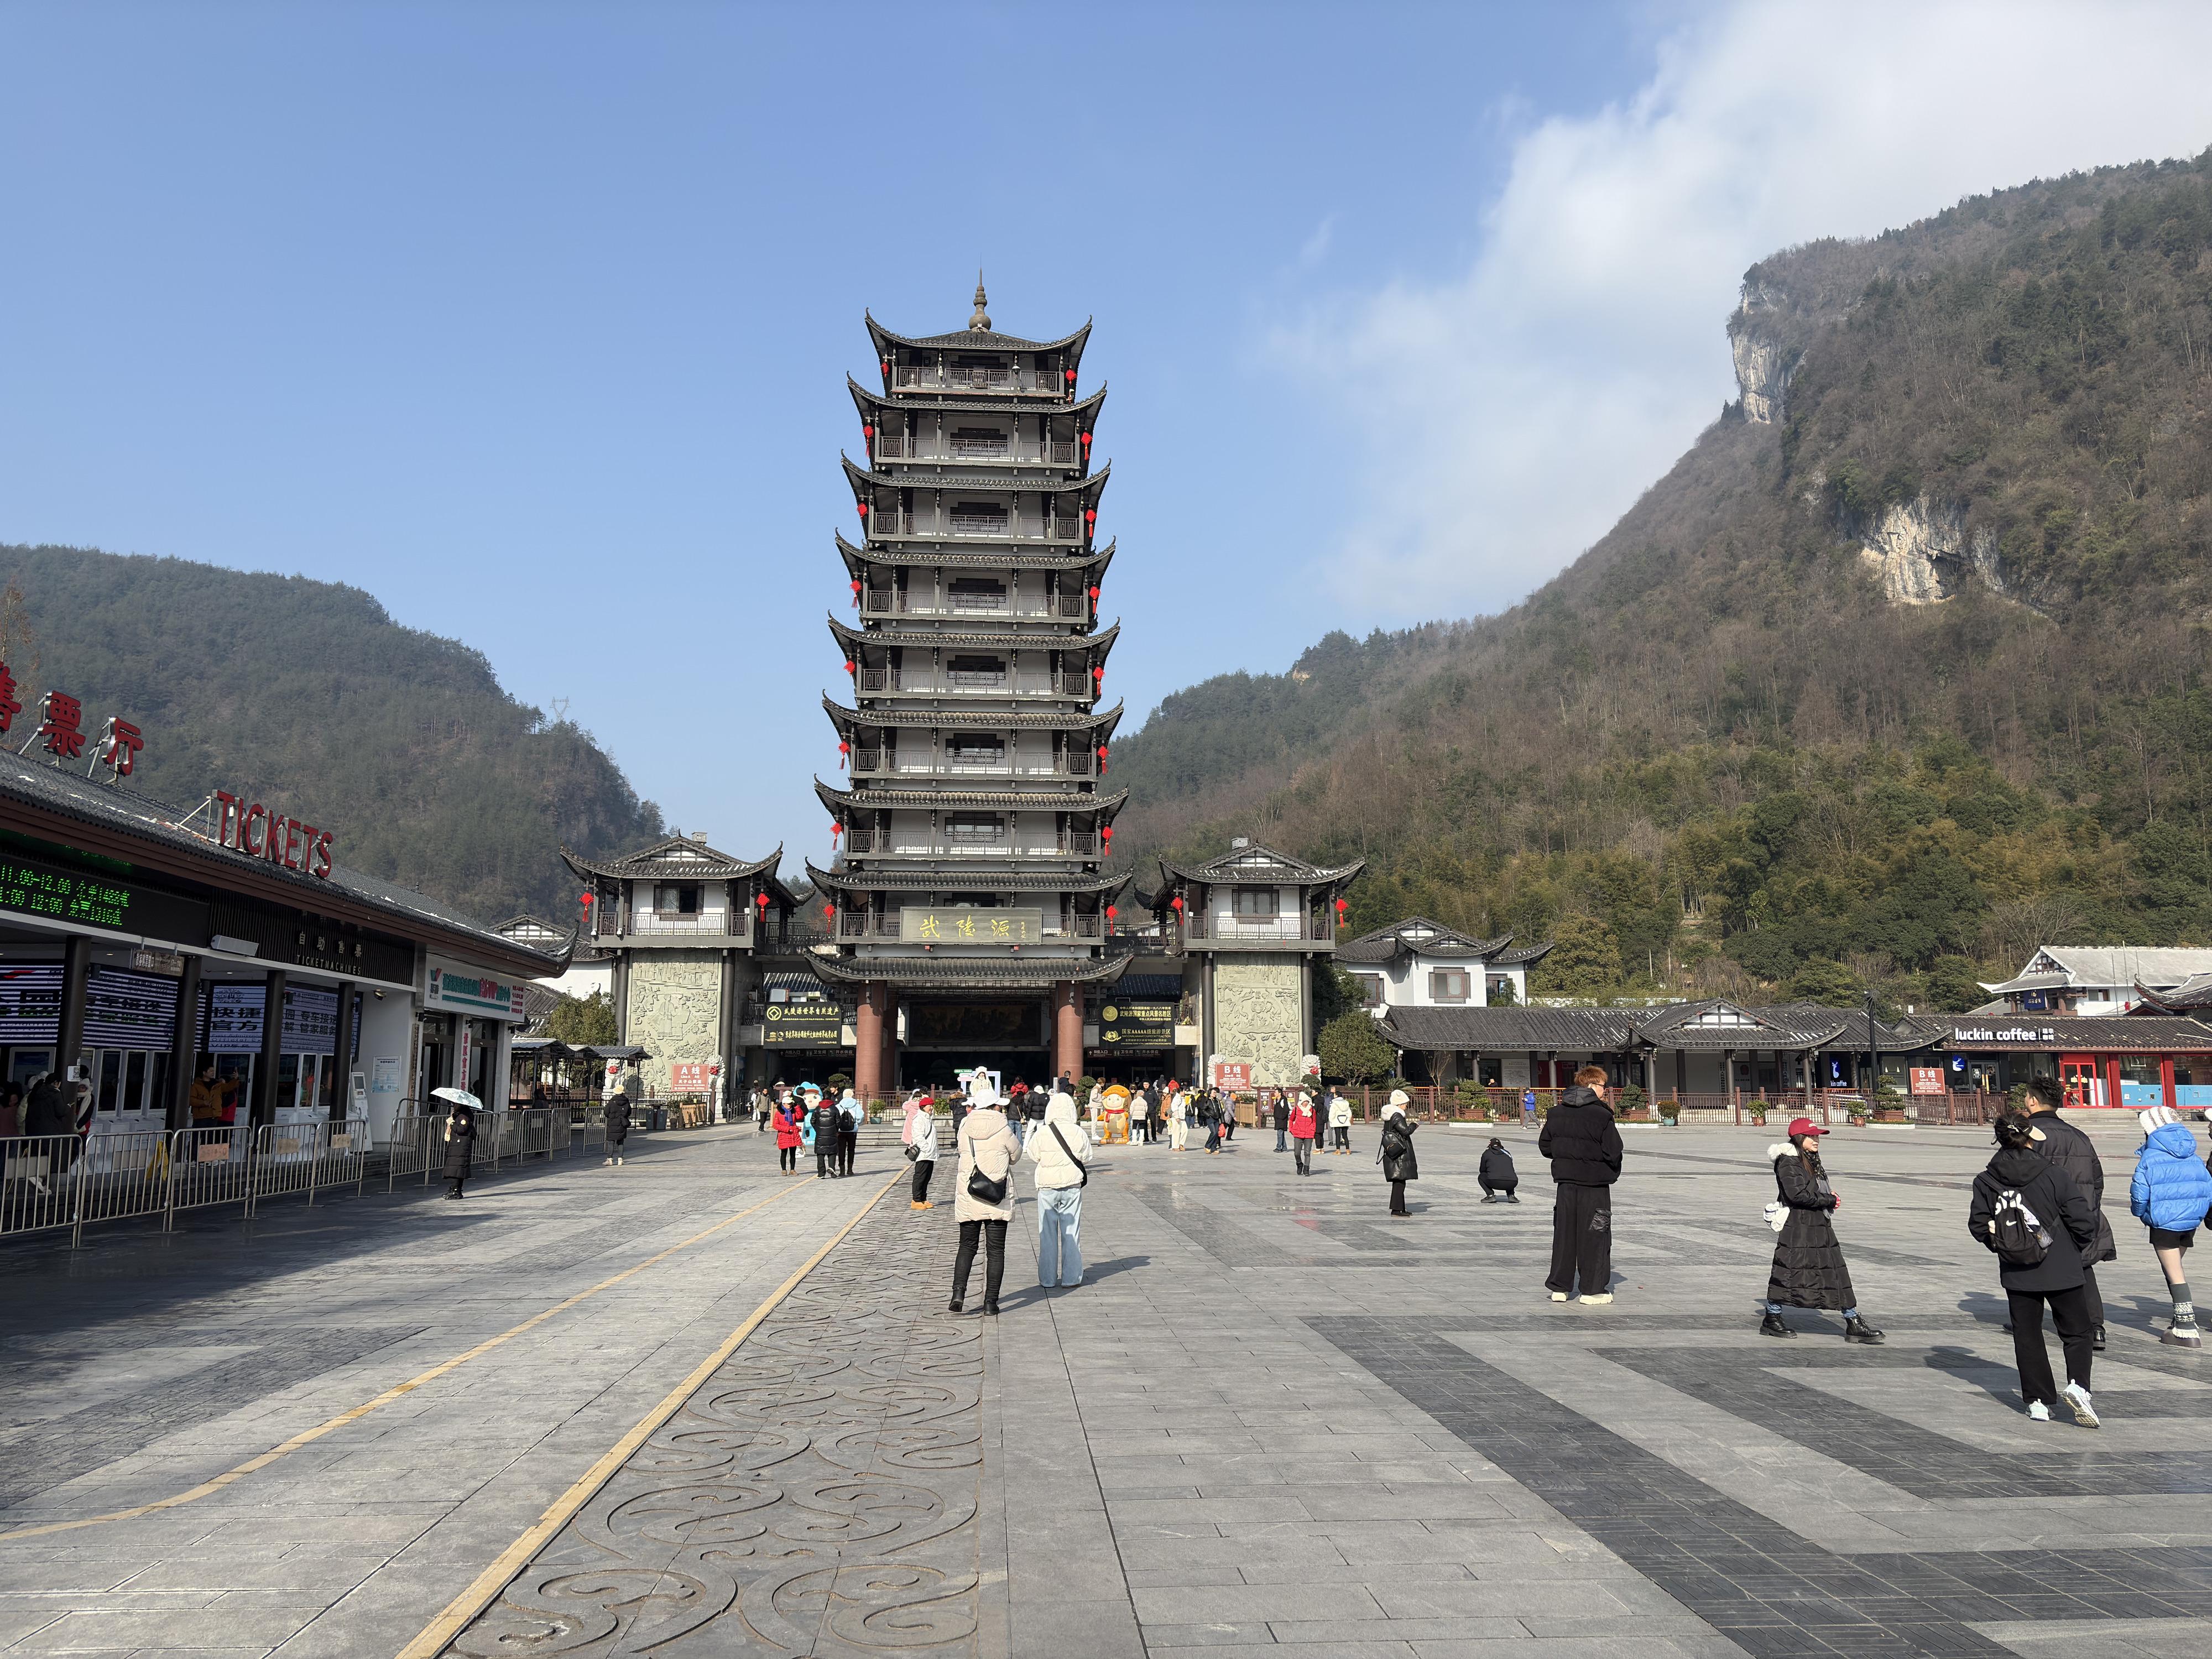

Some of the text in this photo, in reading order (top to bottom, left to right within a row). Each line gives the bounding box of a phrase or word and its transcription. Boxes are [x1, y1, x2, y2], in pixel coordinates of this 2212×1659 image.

[212, 789, 333, 879] TICKETS
[919, 914, 1010, 938] 武陵源
[299, 931, 362, 958] 自助售票
[784, 1006, 839, 1015] 武陵源世界自然遗产
[1955, 1027, 2036, 1041] luckin coffee
